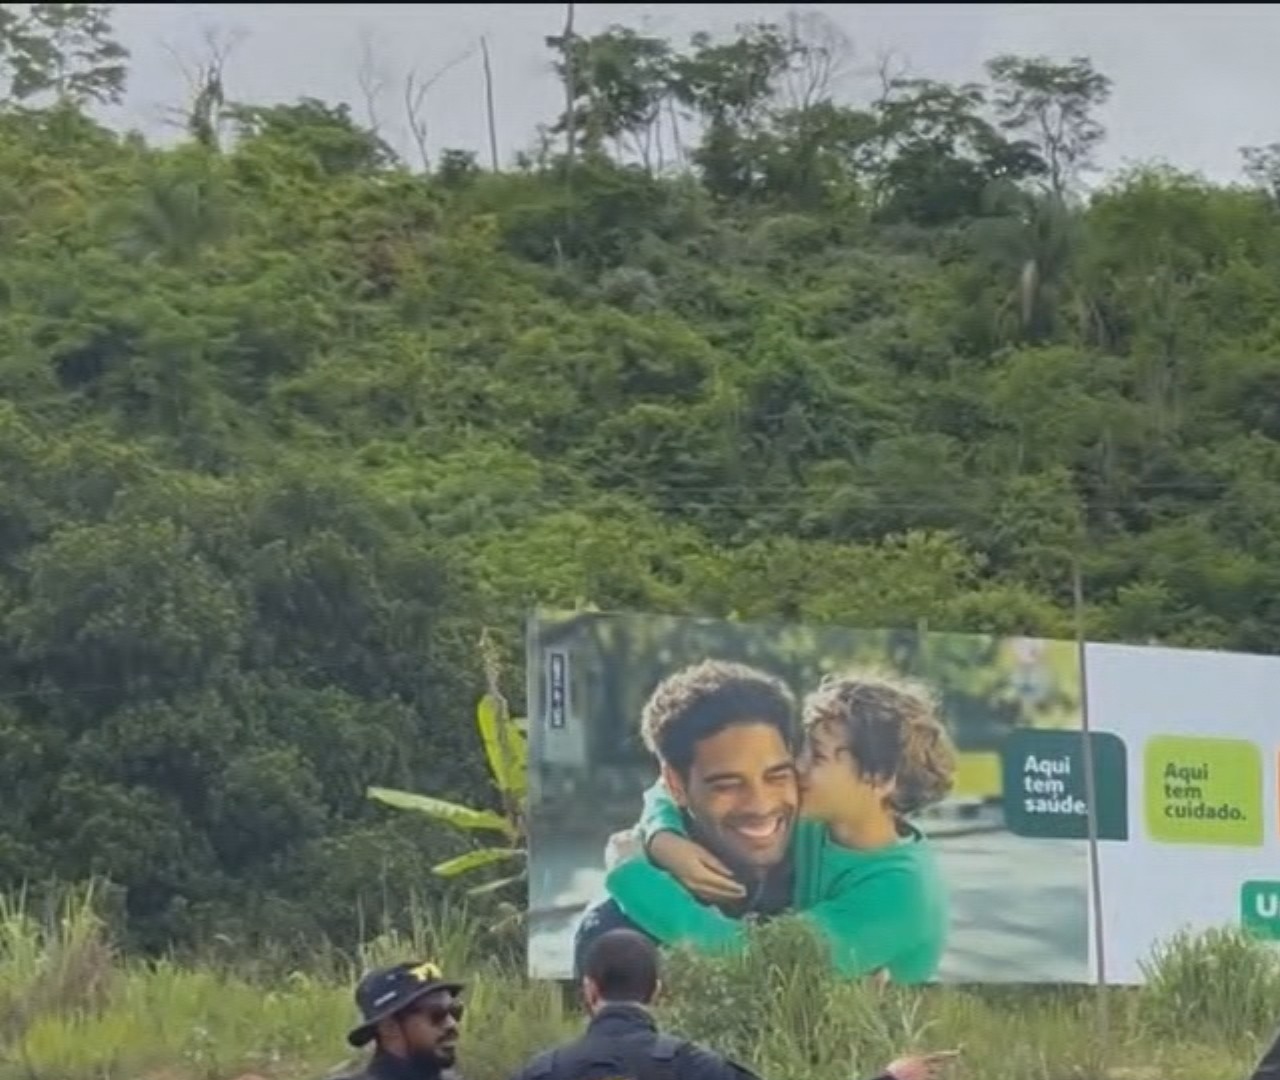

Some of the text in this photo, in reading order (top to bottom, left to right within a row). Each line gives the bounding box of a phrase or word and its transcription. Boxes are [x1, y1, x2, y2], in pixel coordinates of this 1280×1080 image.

[1023, 754, 1071, 777] Aqui
[1164, 762, 1208, 782] Aqui
[1023, 776, 1064, 794] tem
[1164, 784, 1203, 799] tem
[1164, 803, 1247, 821] cuidado.
